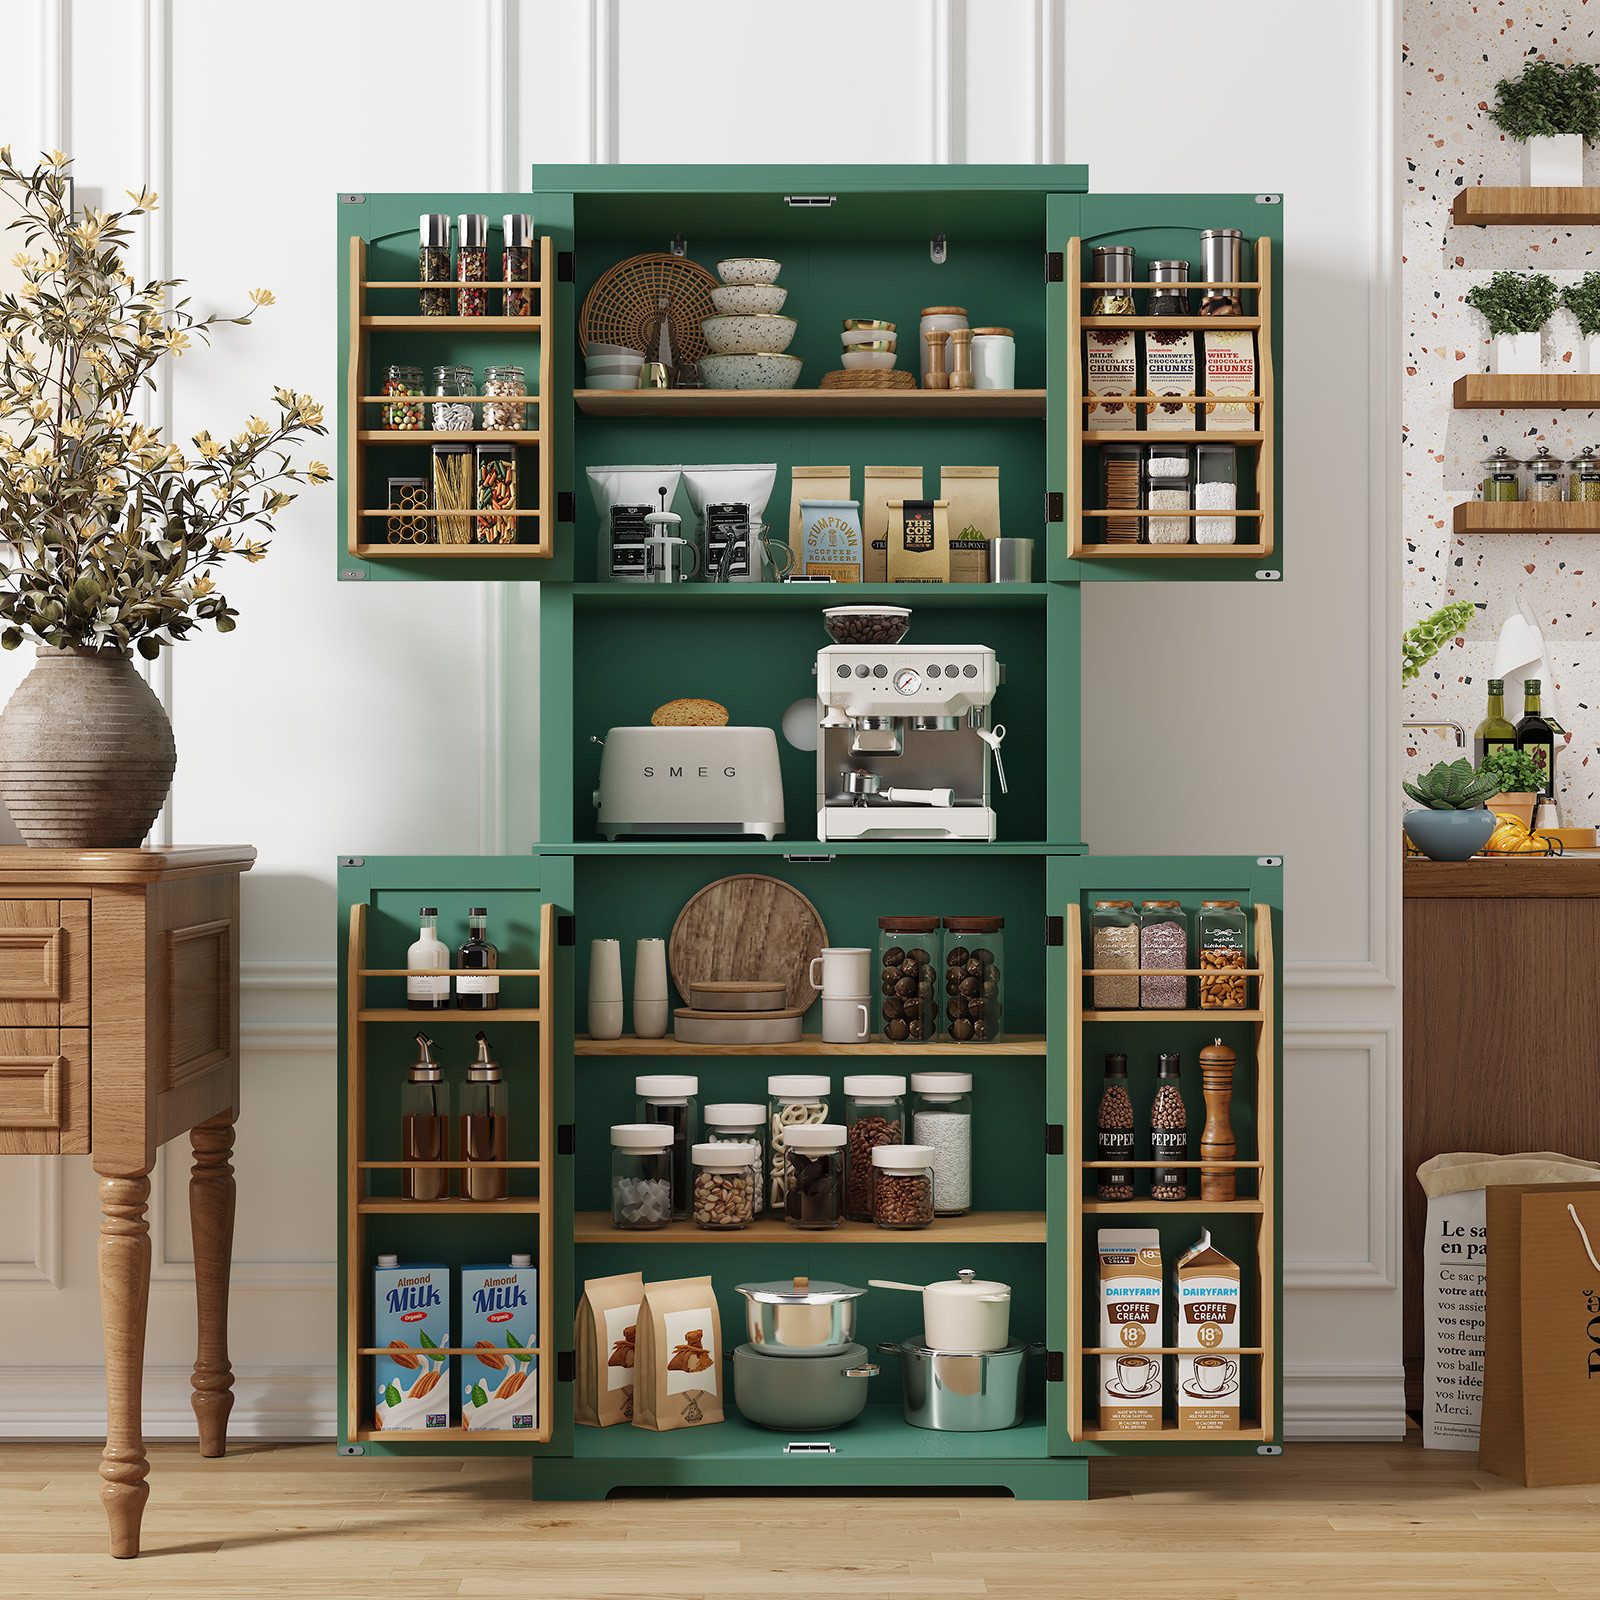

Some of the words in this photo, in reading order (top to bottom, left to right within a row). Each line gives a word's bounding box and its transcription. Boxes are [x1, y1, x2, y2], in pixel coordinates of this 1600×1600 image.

[808, 516, 858, 546] STUMPTOWN
[906, 535, 931, 543] FEE
[952, 540, 968, 548] TRÊS
[644, 766, 736, 777] SMEG
[1100, 1133, 1134, 1146] PEPPER
[1152, 1133, 1187, 1146] PEPPER
[1442, 1221, 1464, 1236] Le
[1470, 1227, 1486, 1237] sa
[1441, 1244, 1462, 1254] en
[1467, 1244, 1486, 1260] pa
[1440, 1270, 1455, 1280] Ce
[398, 1274, 430, 1288] Almond
[484, 1274, 516, 1288] Almond
[1438, 1288, 1467, 1296] votre
[386, 1284, 442, 1314] Milk
[472, 1285, 528, 1314] Milk
[1116, 1304, 1150, 1312] COFFEE
[1193, 1304, 1227, 1312] COFFEE
[404, 1313, 423, 1321] Organic
[490, 1314, 510, 1322] Organic
[1460, 1319, 1484, 1329] espo
[1458, 1360, 1484, 1372] balle
[1436, 1377, 1456, 1385] vos
[1458, 1376, 1482, 1386] idée
[1435, 1403, 1472, 1416] Merci.
